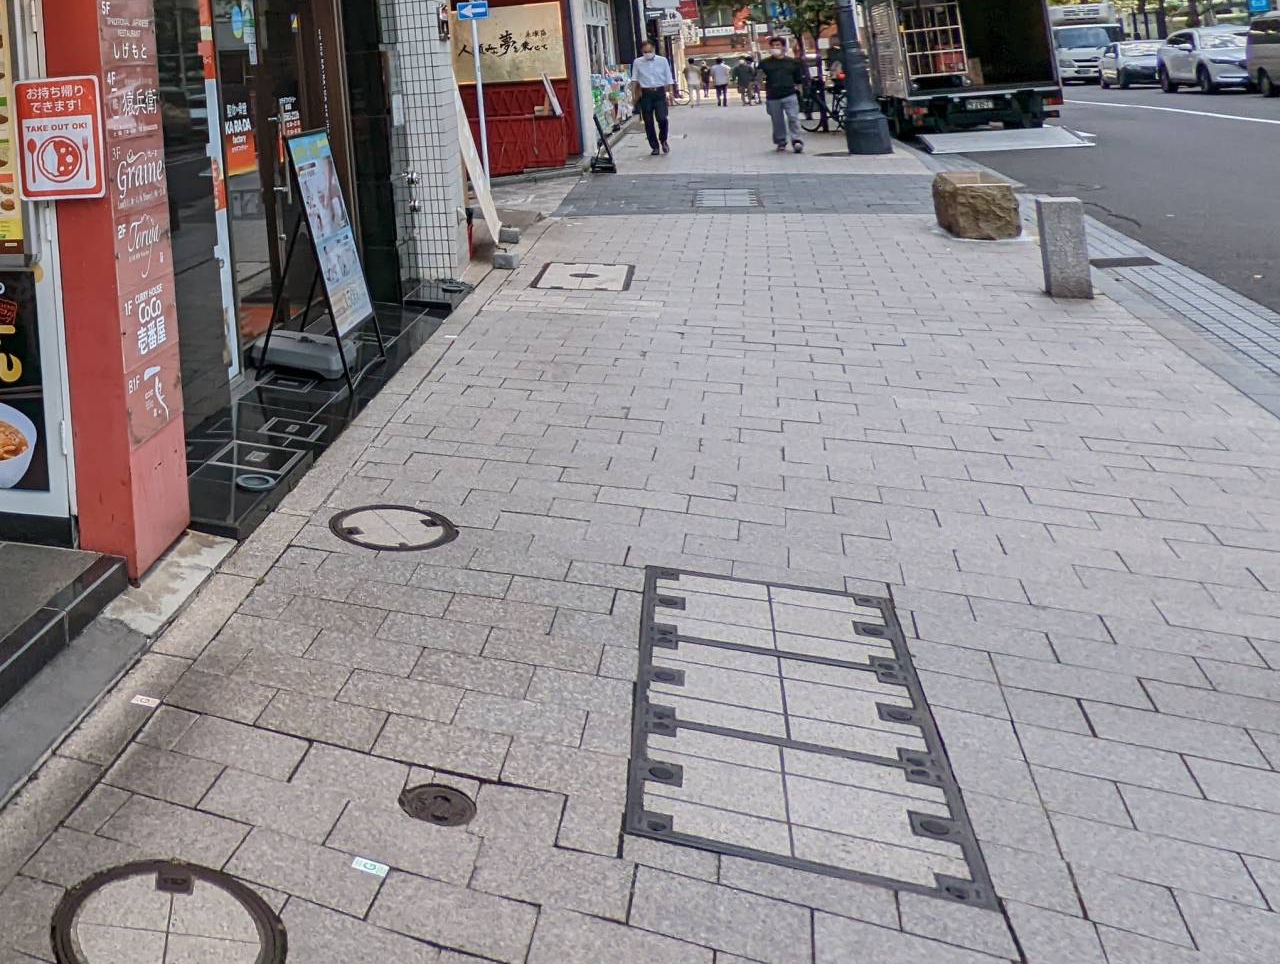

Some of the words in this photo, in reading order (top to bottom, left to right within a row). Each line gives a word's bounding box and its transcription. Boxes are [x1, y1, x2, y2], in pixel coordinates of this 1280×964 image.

[101, 1, 111, 15] 5F
[113, 43, 148, 59] しげもと
[107, 71, 116, 85] 4F
[26, 85, 84, 100] お持ち帰り
[26, 124, 48, 133] TAKE
[51, 123, 69, 131] OUT
[72, 122, 88, 130] OK!
[112, 147, 121, 161] 3F
[117, 160, 164, 199] Graine
[118, 224, 126, 239] 2F
[135, 292, 148, 304] CURRY
[148, 284, 163, 297] HOUSE
[125, 301, 133, 316] 1F
[138, 297, 162, 324] CoCo
[137, 316, 167, 355] 壱番屋
[128, 376, 140, 394] B1F
